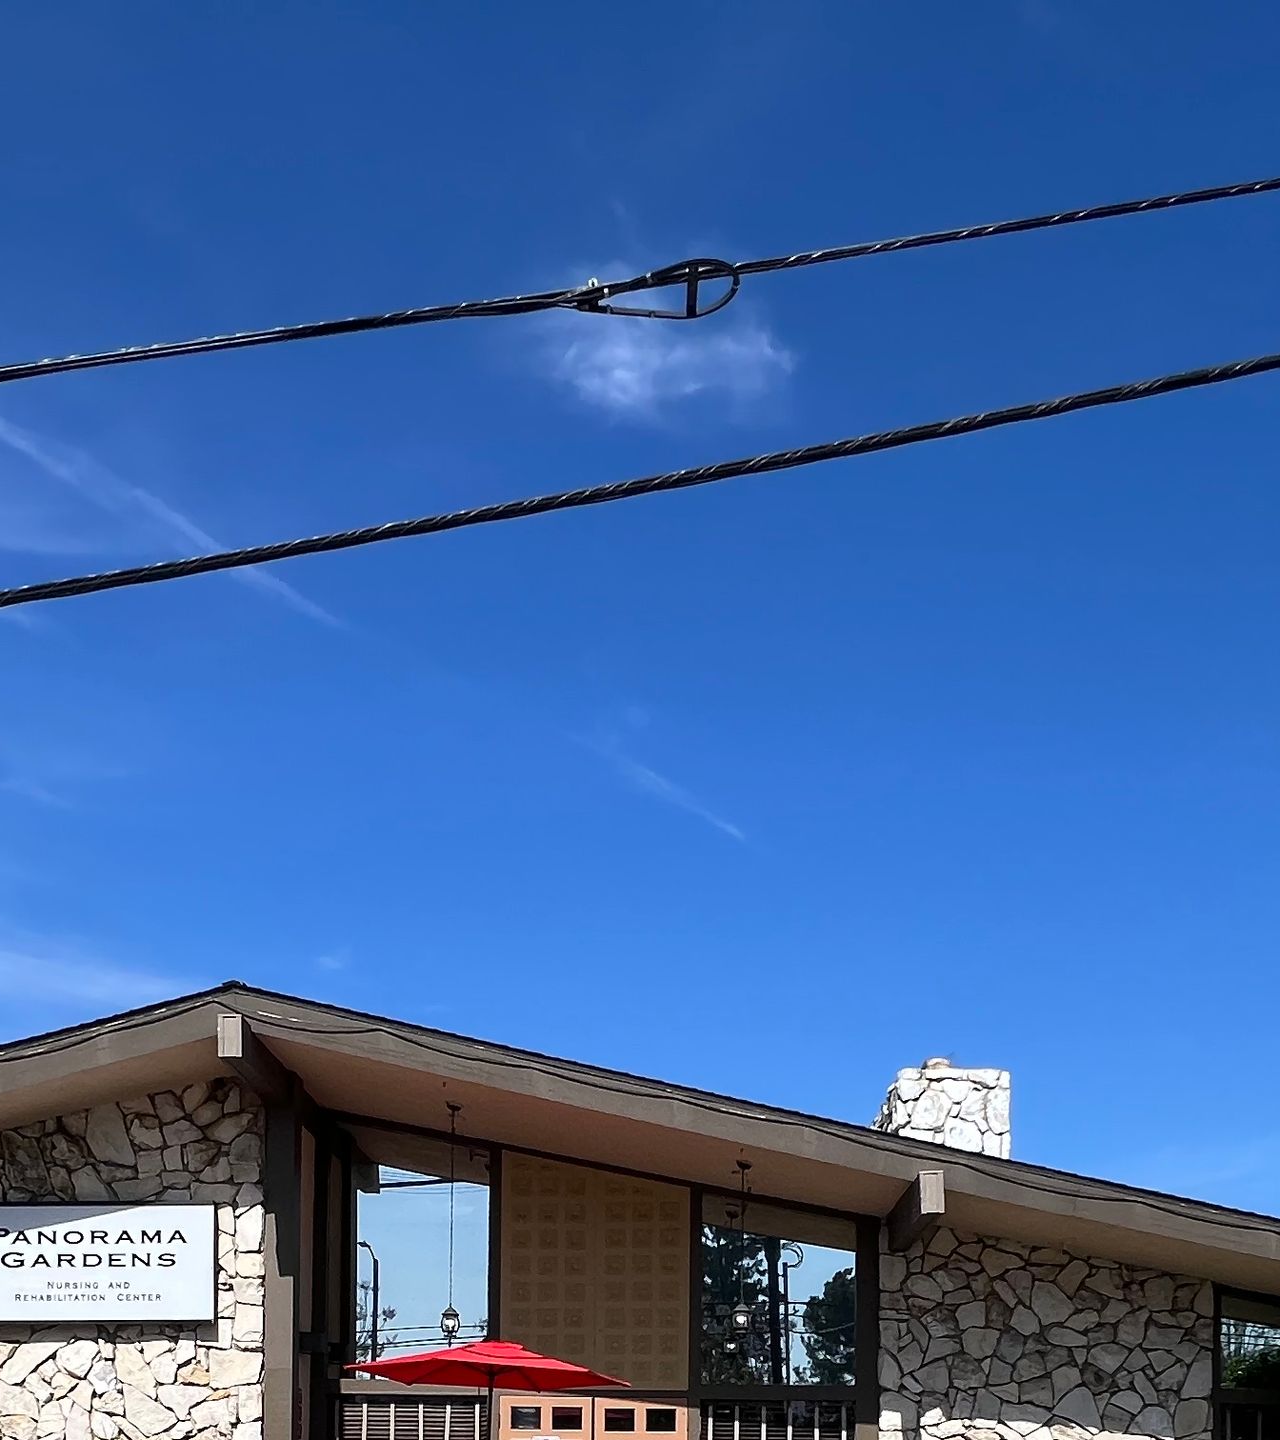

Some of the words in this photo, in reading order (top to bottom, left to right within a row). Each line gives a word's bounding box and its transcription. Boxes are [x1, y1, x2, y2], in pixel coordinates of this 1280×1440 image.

[0, 1251, 177, 1269] GARDENS
[47, 1281, 99, 1290] NURSING
[107, 1281, 131, 1290] AND
[14, 1293, 106, 1302] REHABILITATION
[116, 1293, 162, 1302] CENTER
